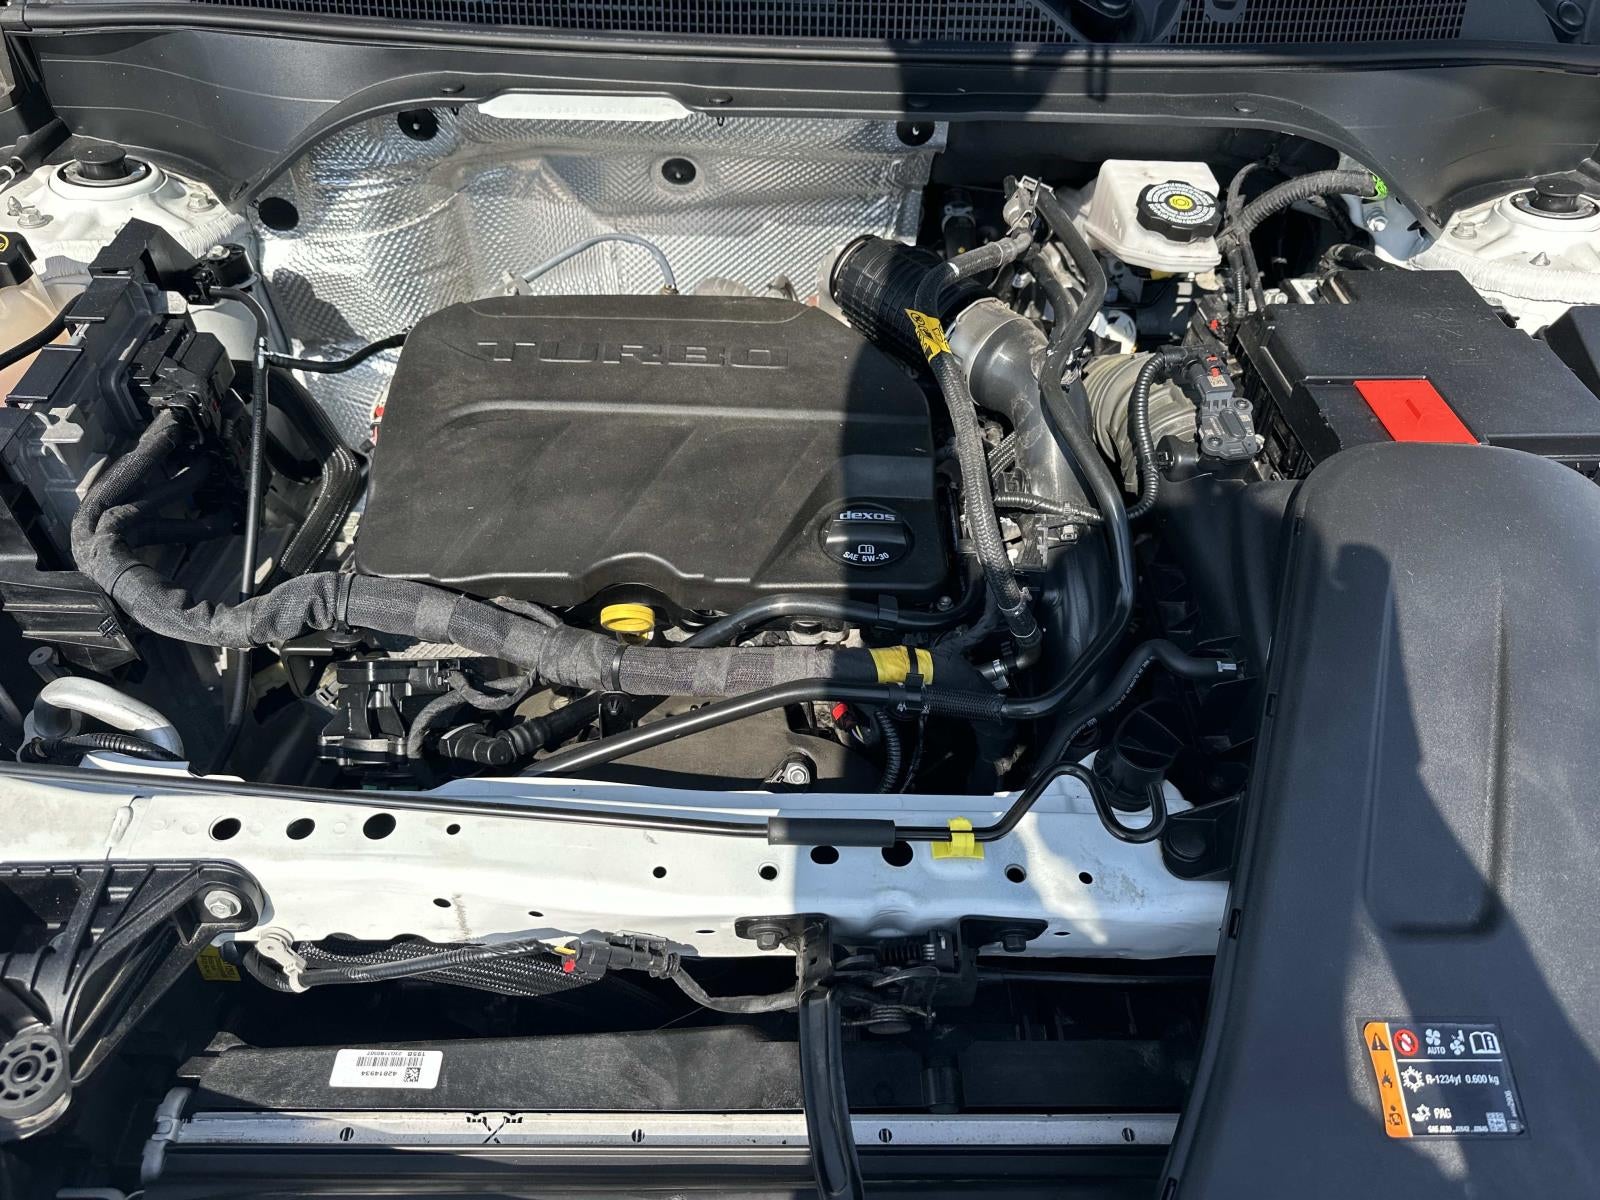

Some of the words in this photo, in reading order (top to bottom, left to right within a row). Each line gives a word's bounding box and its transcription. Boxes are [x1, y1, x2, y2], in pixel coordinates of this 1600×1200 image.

[477, 340, 789, 369] TURBO
[839, 510, 897, 521] dexos
[842, 551, 860, 562] SAE
[861, 551, 890, 562] 5W-30
[1427, 1046, 1446, 1055] AUTO
[1465, 1074, 1488, 1085] 0.600
[1488, 1074, 1500, 1087] kg
[1433, 1107, 1452, 1119] PAG
